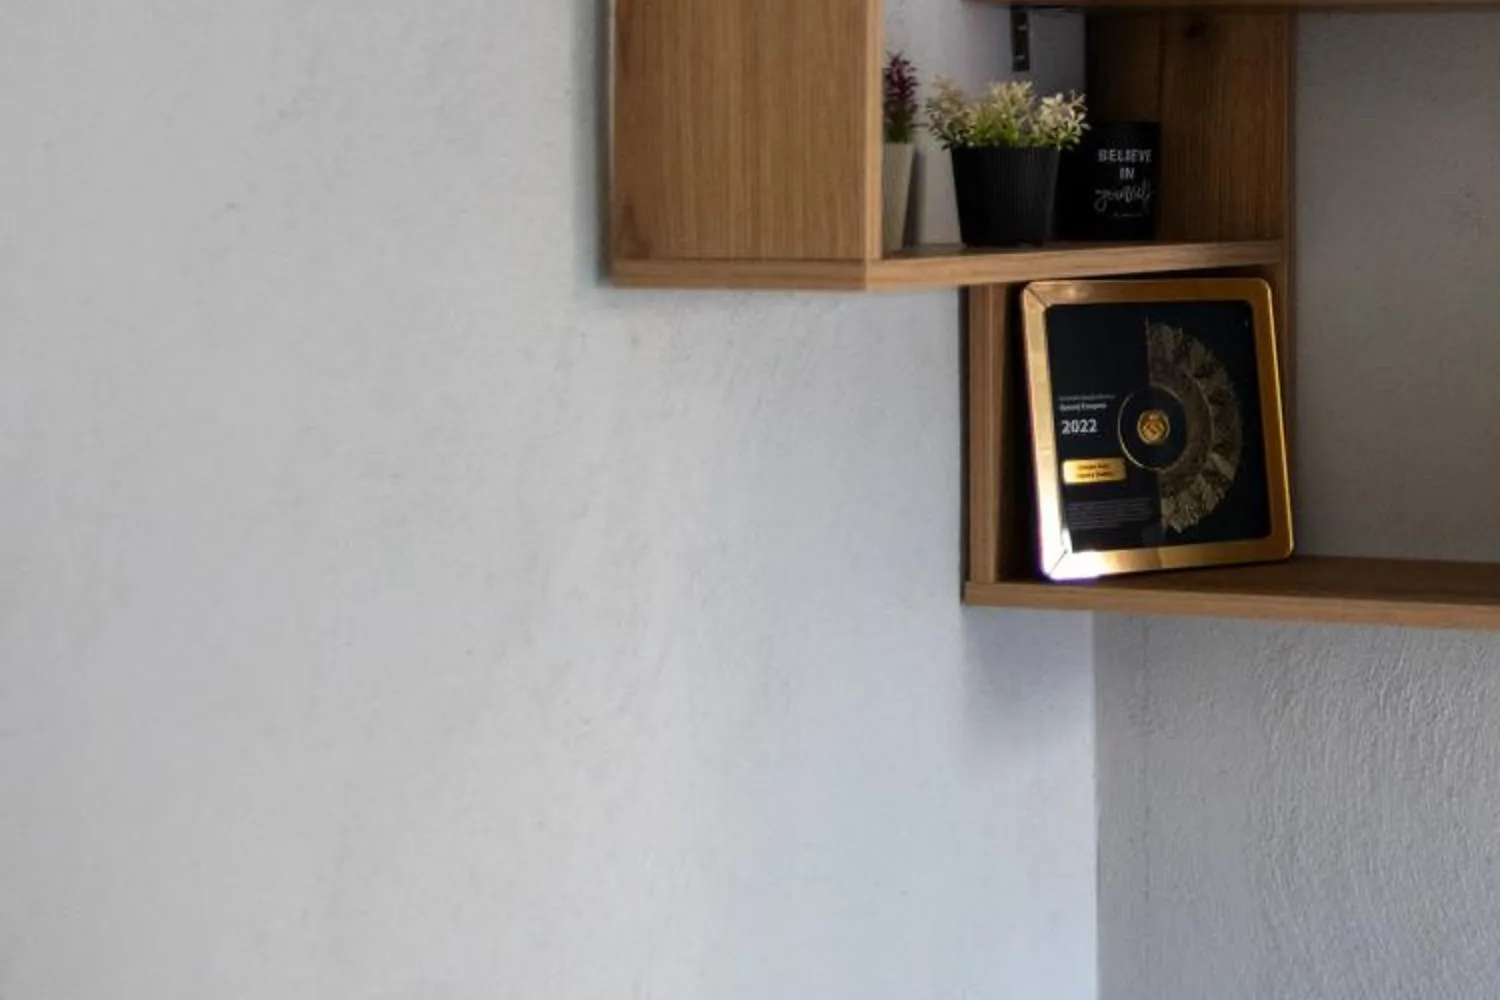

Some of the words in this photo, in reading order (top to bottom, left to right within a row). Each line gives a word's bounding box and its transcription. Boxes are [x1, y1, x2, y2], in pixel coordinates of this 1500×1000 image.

[1097, 148, 1152, 162] BELIEVE
[1119, 167, 1135, 179] IN
[1061, 418, 1098, 435] 2022
